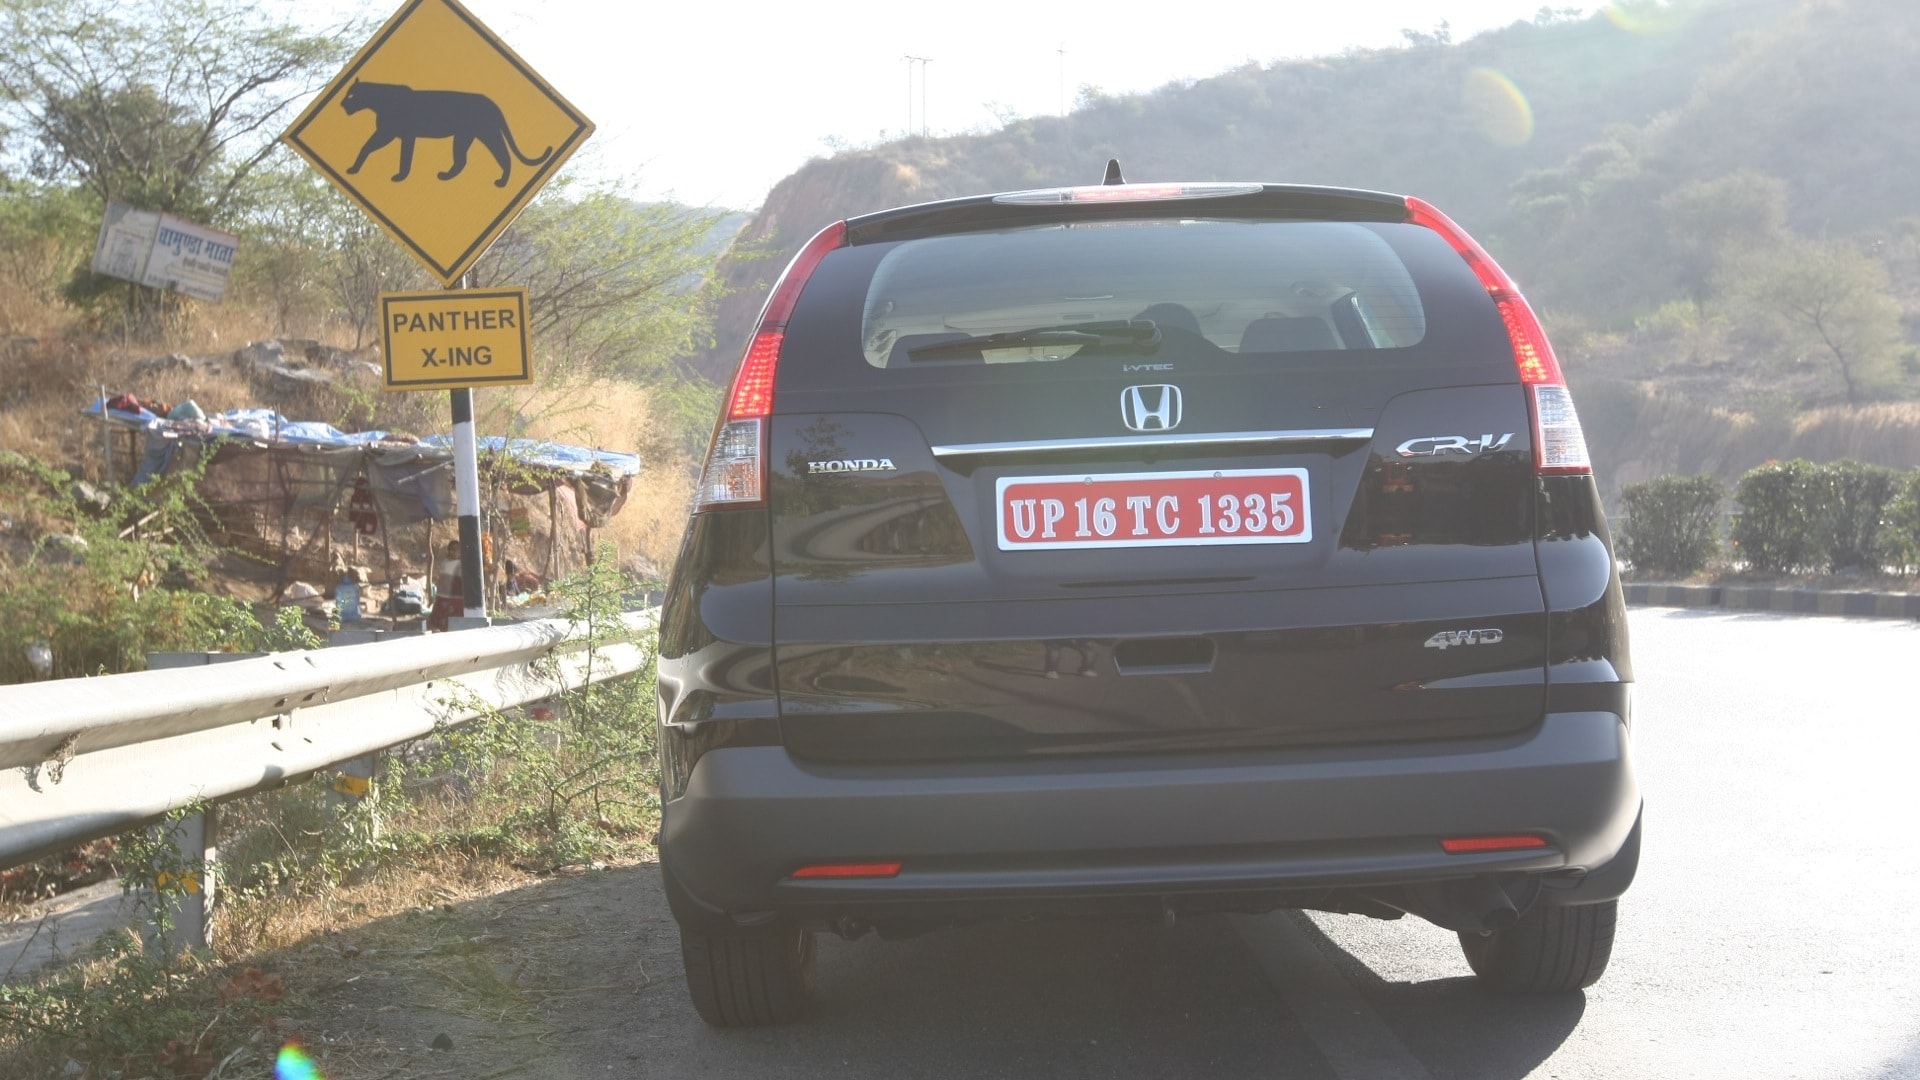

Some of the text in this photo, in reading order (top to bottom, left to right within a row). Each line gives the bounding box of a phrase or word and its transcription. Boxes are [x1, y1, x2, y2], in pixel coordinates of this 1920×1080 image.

[392, 309, 516, 333] PANTHER
[421, 346, 492, 367] X-ING
[1395, 432, 1515, 457] CR-V
[808, 458, 897, 474] HONDA
[1010, 491, 1294, 538] UP 16 TC 1335
[1424, 629, 1503, 650] 4WD
